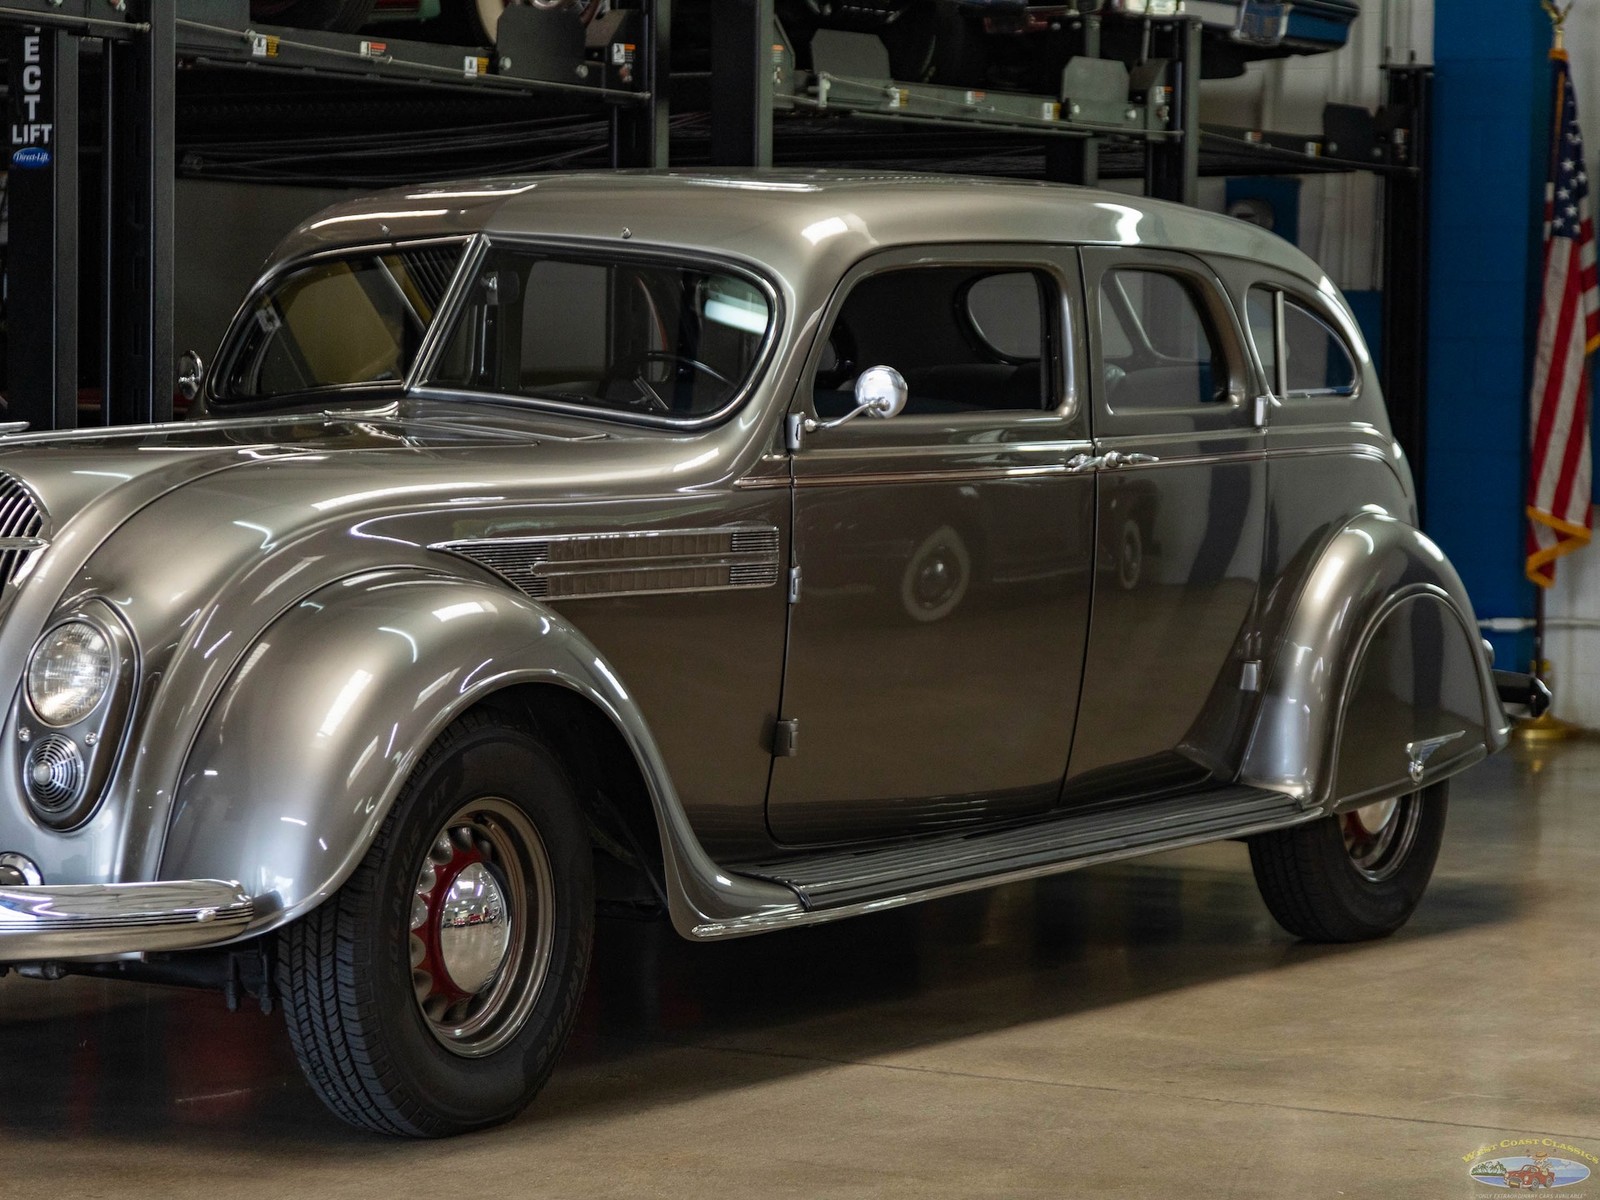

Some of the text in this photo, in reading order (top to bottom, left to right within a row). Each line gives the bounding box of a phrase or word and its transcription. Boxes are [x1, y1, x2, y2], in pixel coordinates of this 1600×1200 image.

[22, 27, 42, 121] ECT
[12, 124, 53, 145] LIFT
[15, 152, 49, 163] Direct-Lift
